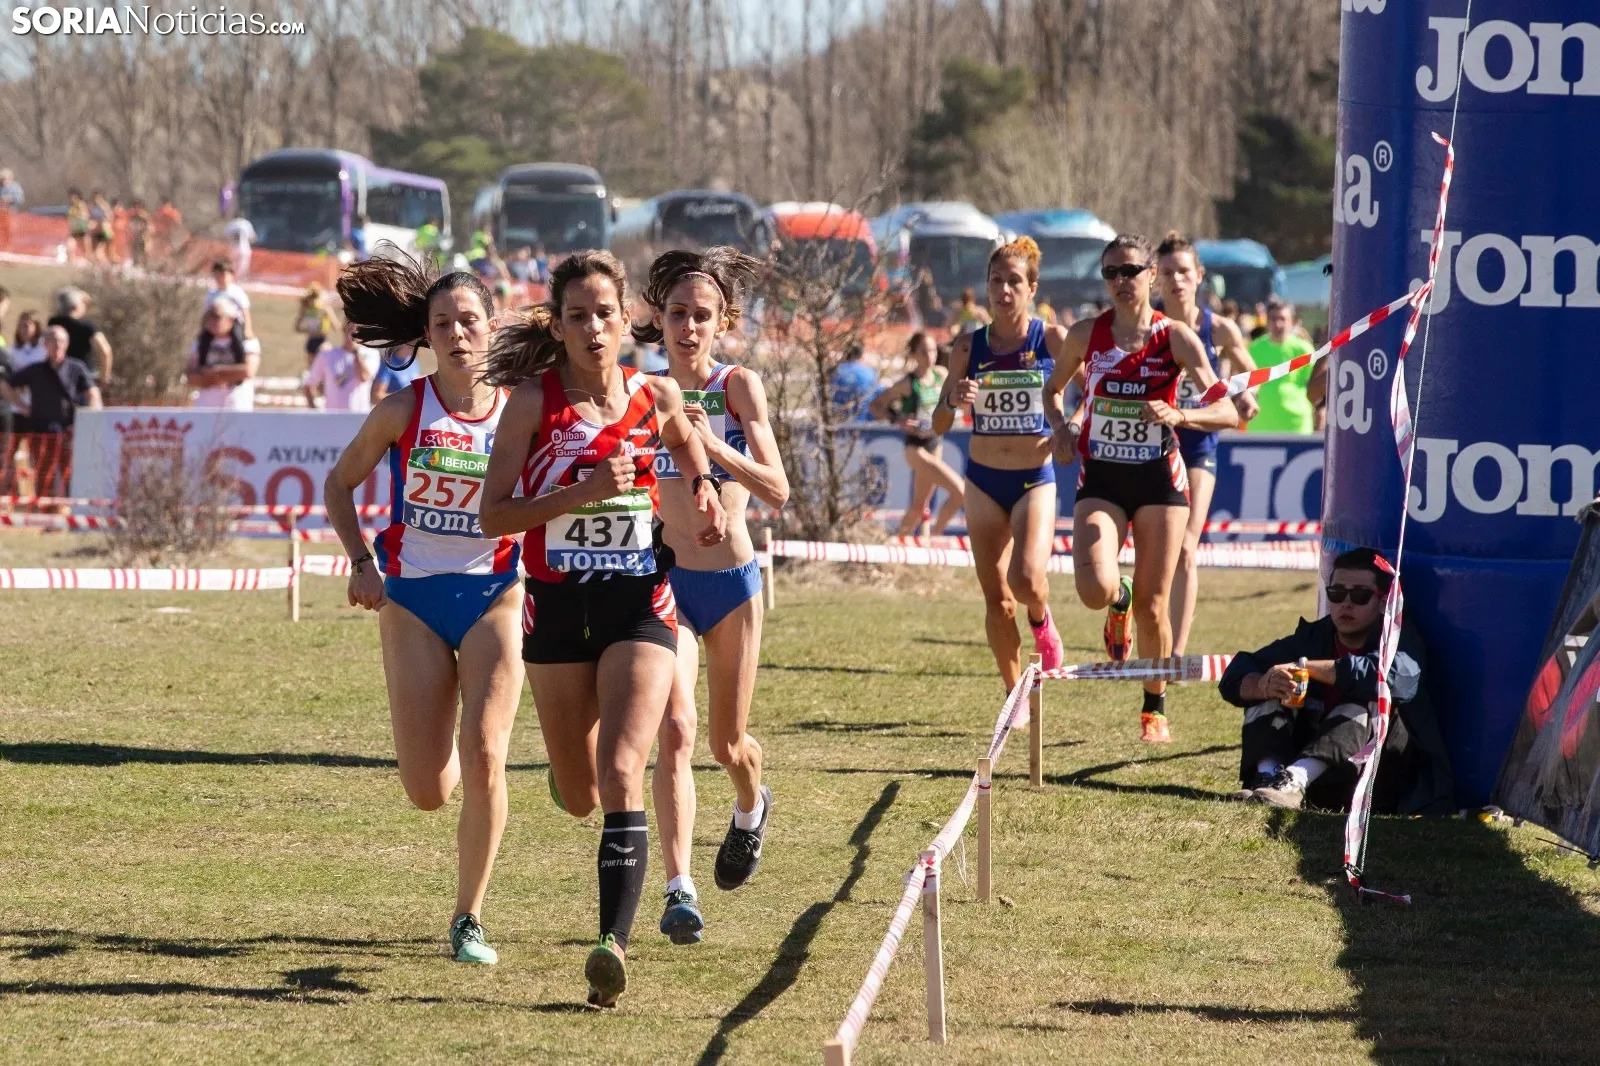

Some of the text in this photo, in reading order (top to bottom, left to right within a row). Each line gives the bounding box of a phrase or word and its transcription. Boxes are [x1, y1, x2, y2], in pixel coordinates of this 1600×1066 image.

[991, 375, 1037, 385] IBERDROLA
[1122, 382, 1146, 394] BM
[984, 390, 1031, 413] 489
[551, 428, 587, 445] Bilbao
[1100, 419, 1149, 443] 438
[555, 448, 598, 457] Guedan
[408, 472, 481, 509] 257
[564, 516, 636, 548] 437
[600, 858, 638, 868] SPORTLAST
